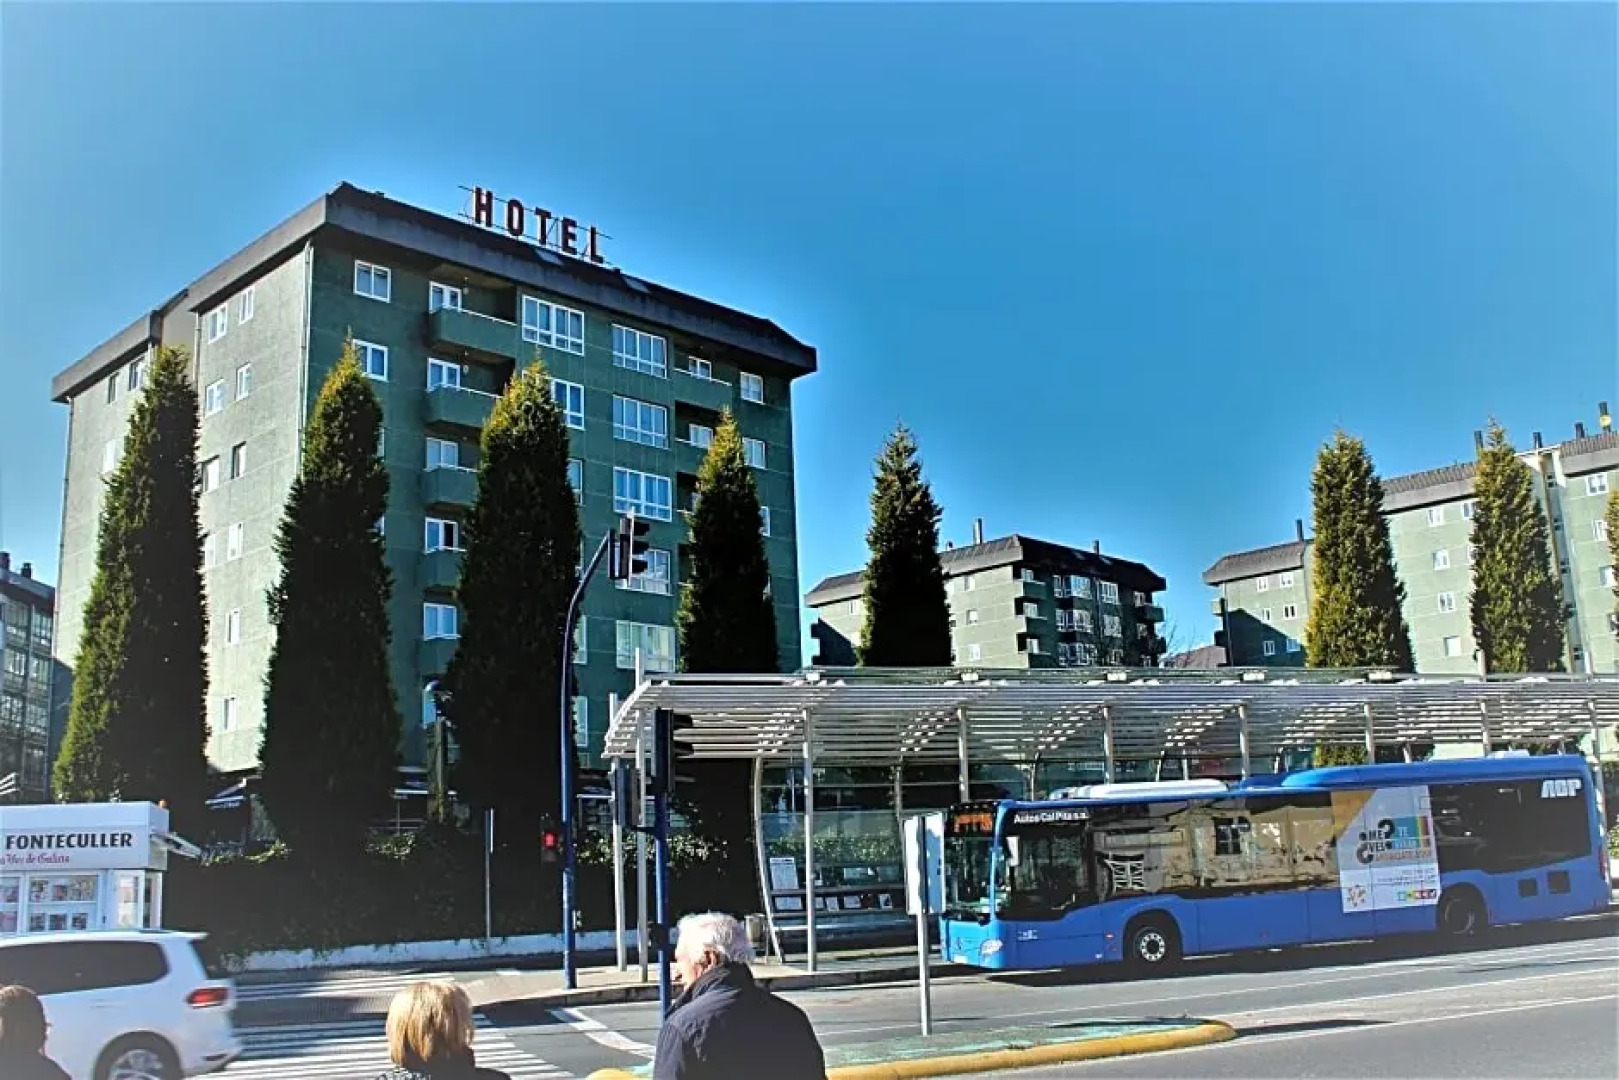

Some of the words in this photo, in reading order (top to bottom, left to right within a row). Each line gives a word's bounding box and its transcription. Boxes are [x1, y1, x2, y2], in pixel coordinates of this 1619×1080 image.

[474, 186, 603, 264] HOTEL
[5, 833, 132, 849] FONTECULLER
[26, 853, 36, 863] de
